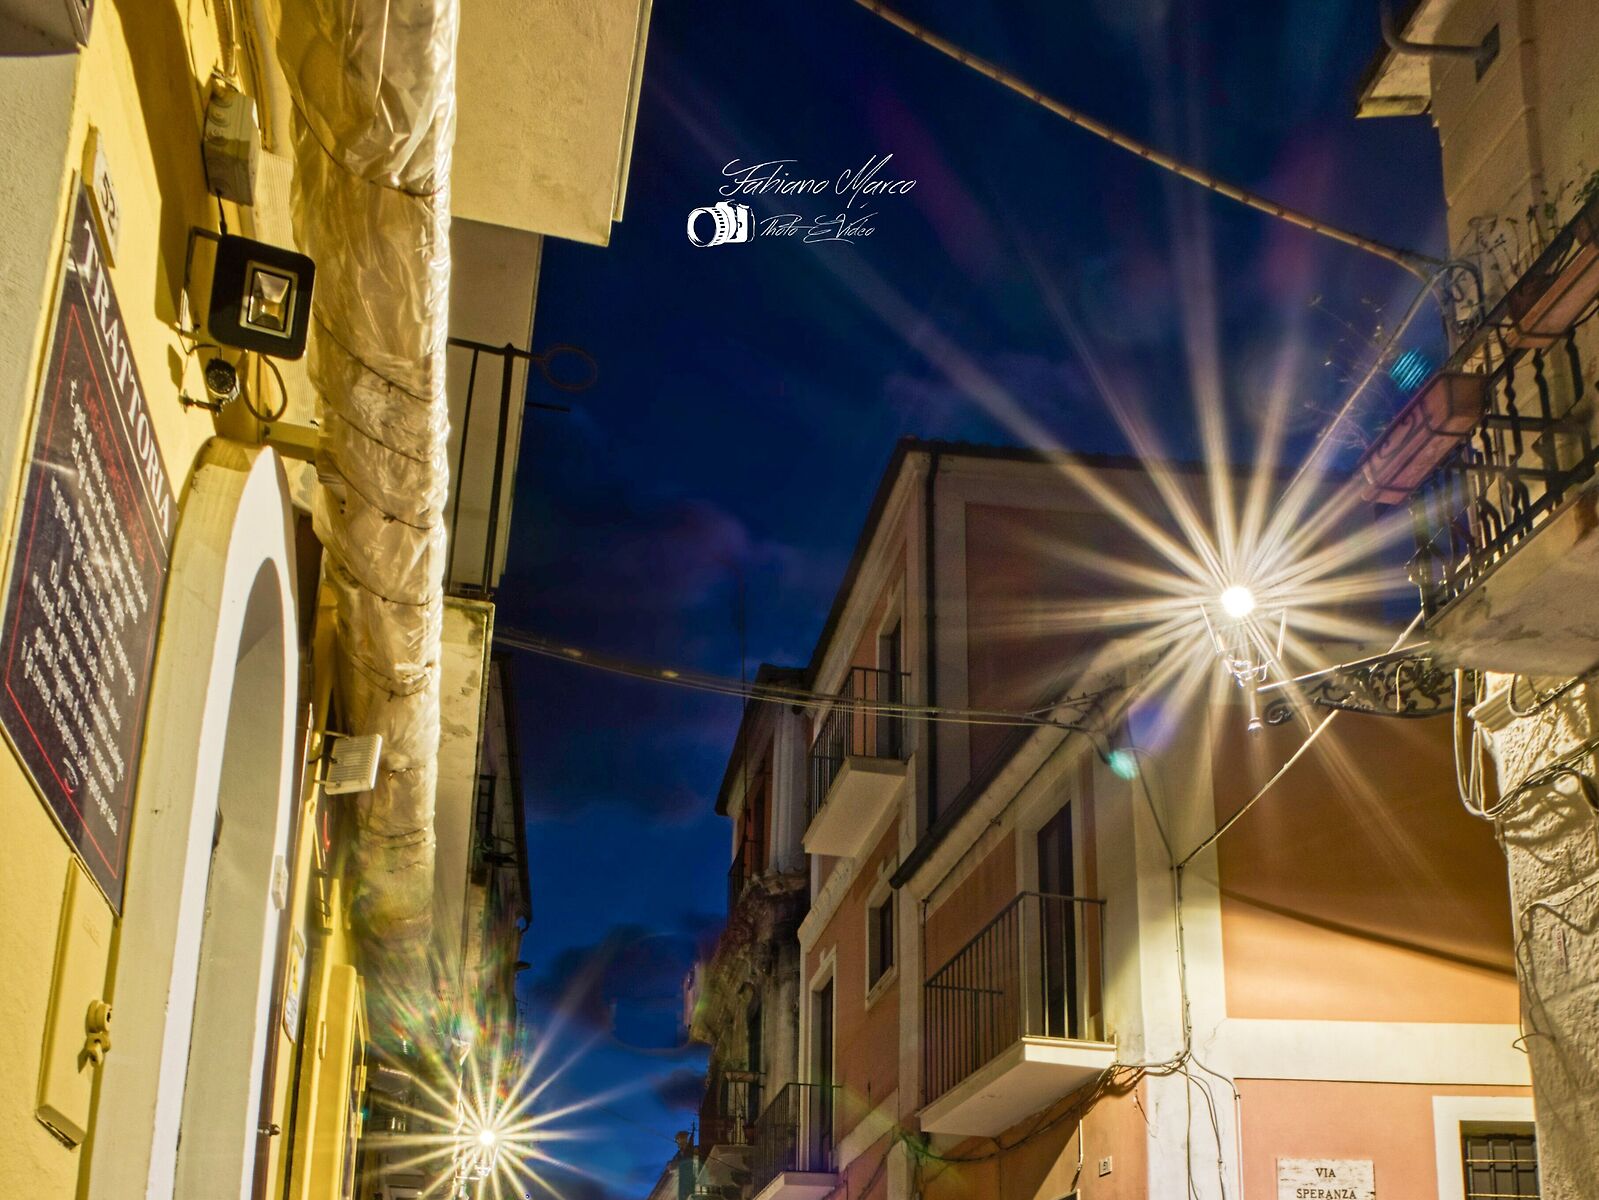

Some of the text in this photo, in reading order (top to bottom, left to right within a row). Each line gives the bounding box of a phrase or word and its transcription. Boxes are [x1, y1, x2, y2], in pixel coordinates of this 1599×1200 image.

[84, 219, 170, 538] TRATTORIA
[1315, 1167, 1336, 1178] VIA
[1296, 1188, 1357, 1200] SPERANZA
